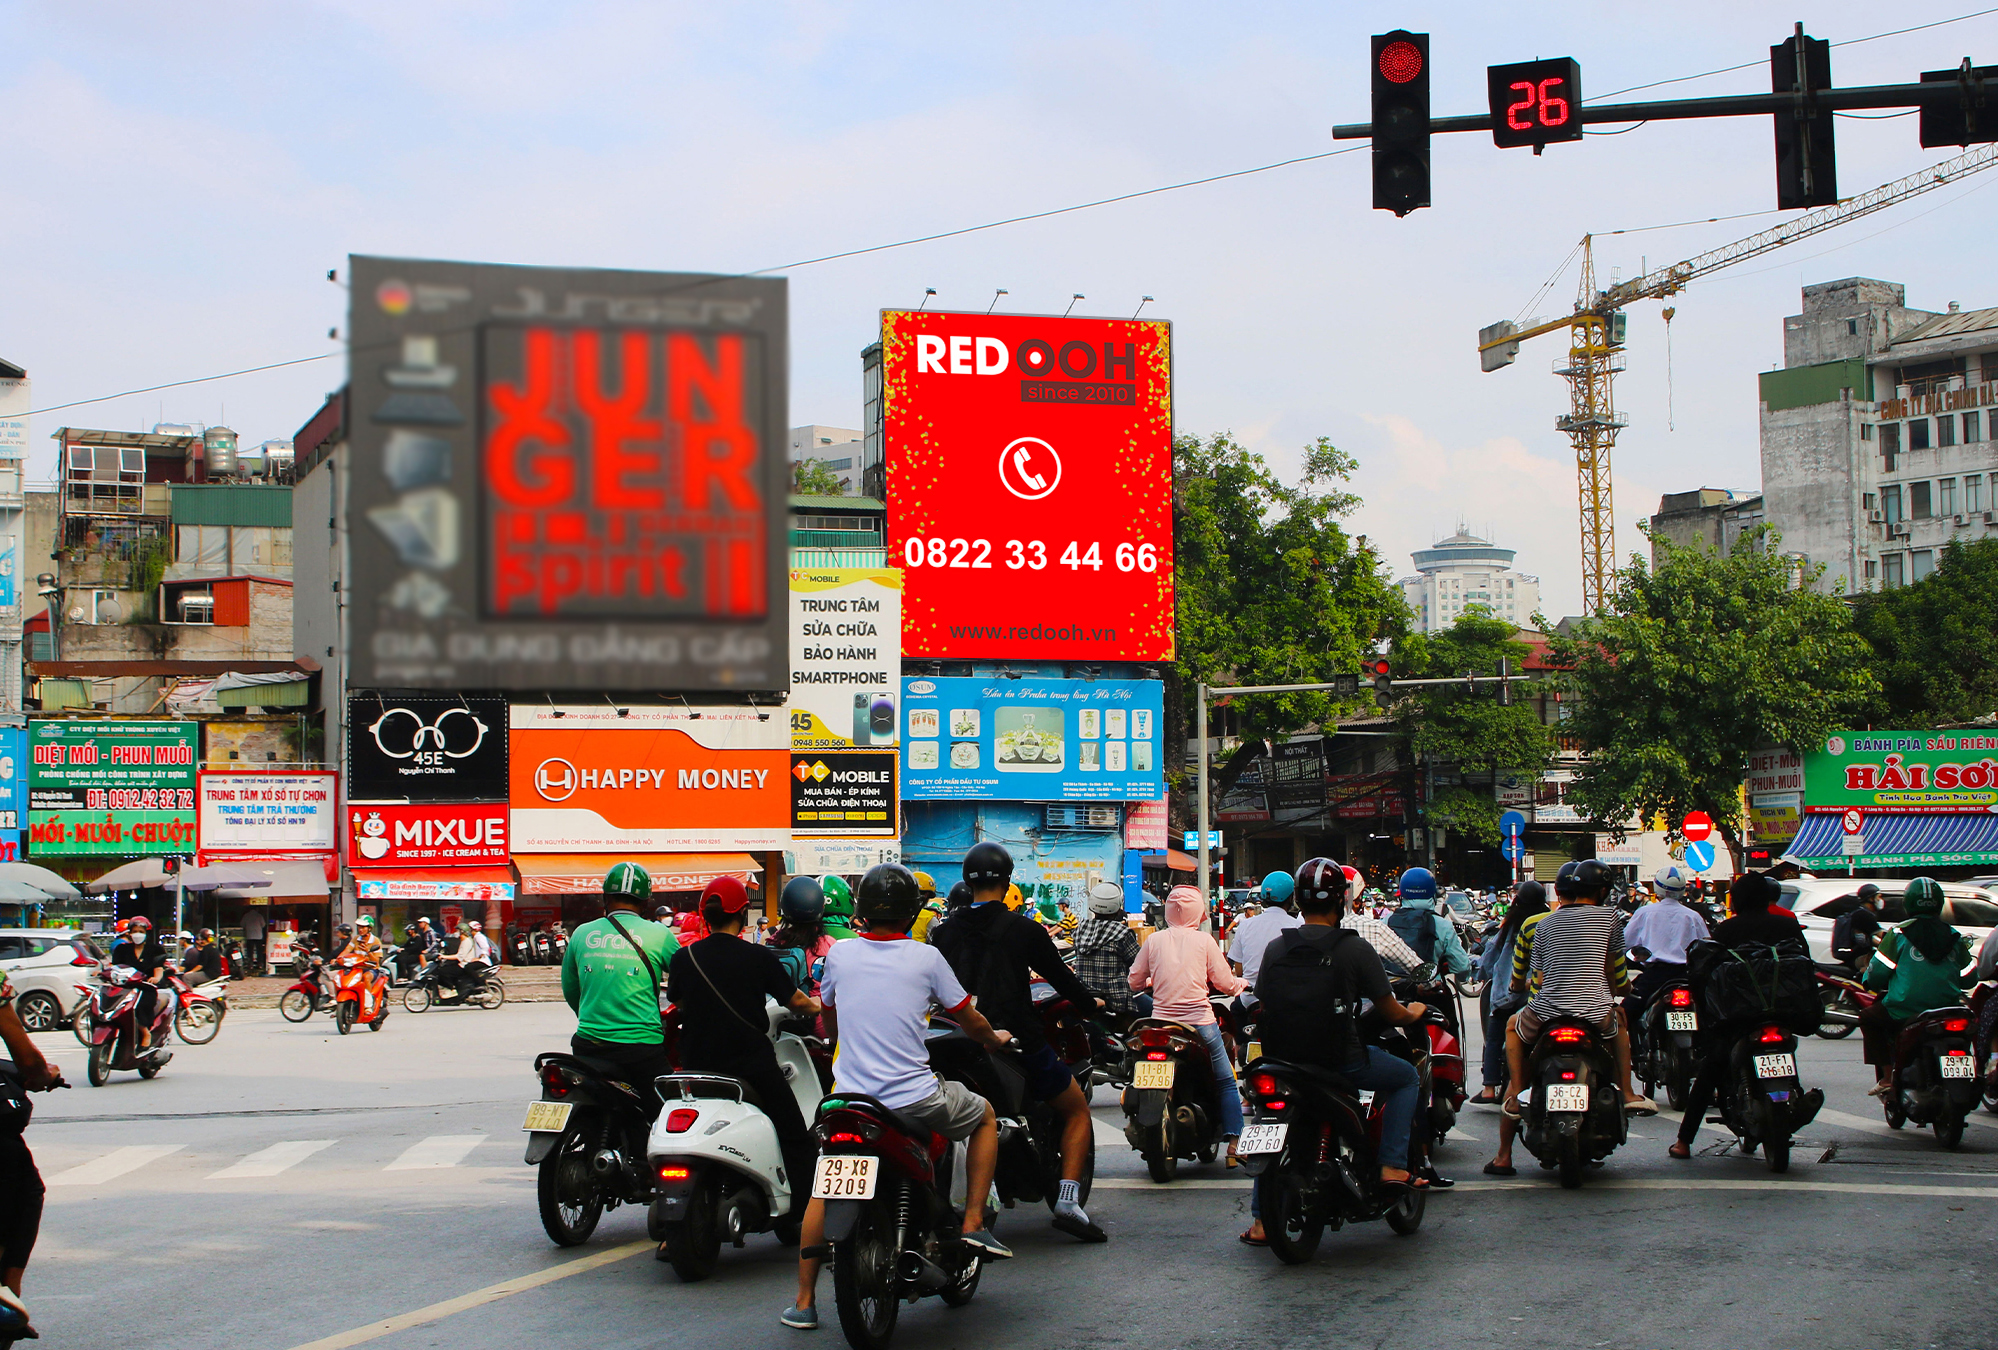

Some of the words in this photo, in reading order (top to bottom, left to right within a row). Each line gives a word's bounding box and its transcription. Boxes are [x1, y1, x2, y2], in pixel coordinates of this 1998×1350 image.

[1508, 78, 1568, 130] 26
[917, 334, 1009, 376] RED
[1016, 338, 1136, 381] OOH
[1028, 384, 1079, 401] since
[1084, 386, 1128, 402] 2010
[904, 537, 993, 569] 0822
[1005, 539, 1048, 570] 33
[1059, 540, 1103, 571] 44
[1115, 542, 1157, 573] 66
[809, 575, 840, 583] MOBILE
[800, 599, 847, 613] TRUNG
[850, 597, 880, 613] TÂM
[803, 619, 832, 636] SỬA
[836, 620, 877, 636] CHỮA
[950, 623, 1116, 643] www.redooh.vn
[803, 643, 833, 660] BẢO
[836, 644, 876, 660] HÀNH
[792, 671, 888, 684] SMARTPHONE
[1050, 691, 1070, 702] trong
[790, 713, 812, 731] 45
[1854, 736, 1892, 751] BÁNH
[1897, 736, 1921, 751] PÍA
[34, 741, 67, 768] DIỆT
[69, 739, 99, 765] MỐI
[111, 745, 152, 765] PHUN
[154, 739, 193, 765] MUỖI
[413, 752, 444, 765] 45E
[832, 771, 890, 783] MOBILE
[1844, 752, 1930, 790] HẢI
[580, 769, 666, 789] HAPPY
[677, 769, 769, 789] MONEY
[206, 790, 236, 801] TRUNG
[239, 788, 258, 801] TÂM
[303, 790, 327, 803] CHỌN
[803, 788, 823, 796] MUA
[824, 786, 842, 796] BÁN
[848, 787, 859, 796] ÉP
[860, 787, 880, 796] KÍNH
[159, 790, 175, 809] 32
[177, 790, 194, 809] 72
[797, 797, 815, 807] SỬA
[815, 797, 838, 807] CHỮA
[861, 798, 887, 808] THOẠI
[218, 805, 244, 814] TRUNG
[247, 804, 264, 814] TÂM
[30, 814, 65, 843] MỐI
[131, 817, 195, 847] CHUỘT
[395, 818, 505, 847] MIXUE
[397, 850, 419, 858] SINCE
[442, 849, 454, 857] ICE
[455, 849, 480, 857] CREAM
[490, 848, 505, 856] TEA
[1860, 855, 1904, 865] BÁNH
[1910, 854, 1936, 863] PÍA
[1940, 853, 1973, 862] SÓC
[585, 929, 643, 951] Grab
[1760, 1055, 1787, 1066] 21-F1
[1141, 1063, 1167, 1074] 11-B1
[1136, 1075, 1170, 1087] 357.96
[1553, 1086, 1581, 1098] 36-C2
[1549, 1099, 1585, 1109] 213.19
[1240, 1138, 1281, 1153] 907.60
[825, 1159, 869, 1176] 29-X8
[822, 1178, 867, 1195] 3209
